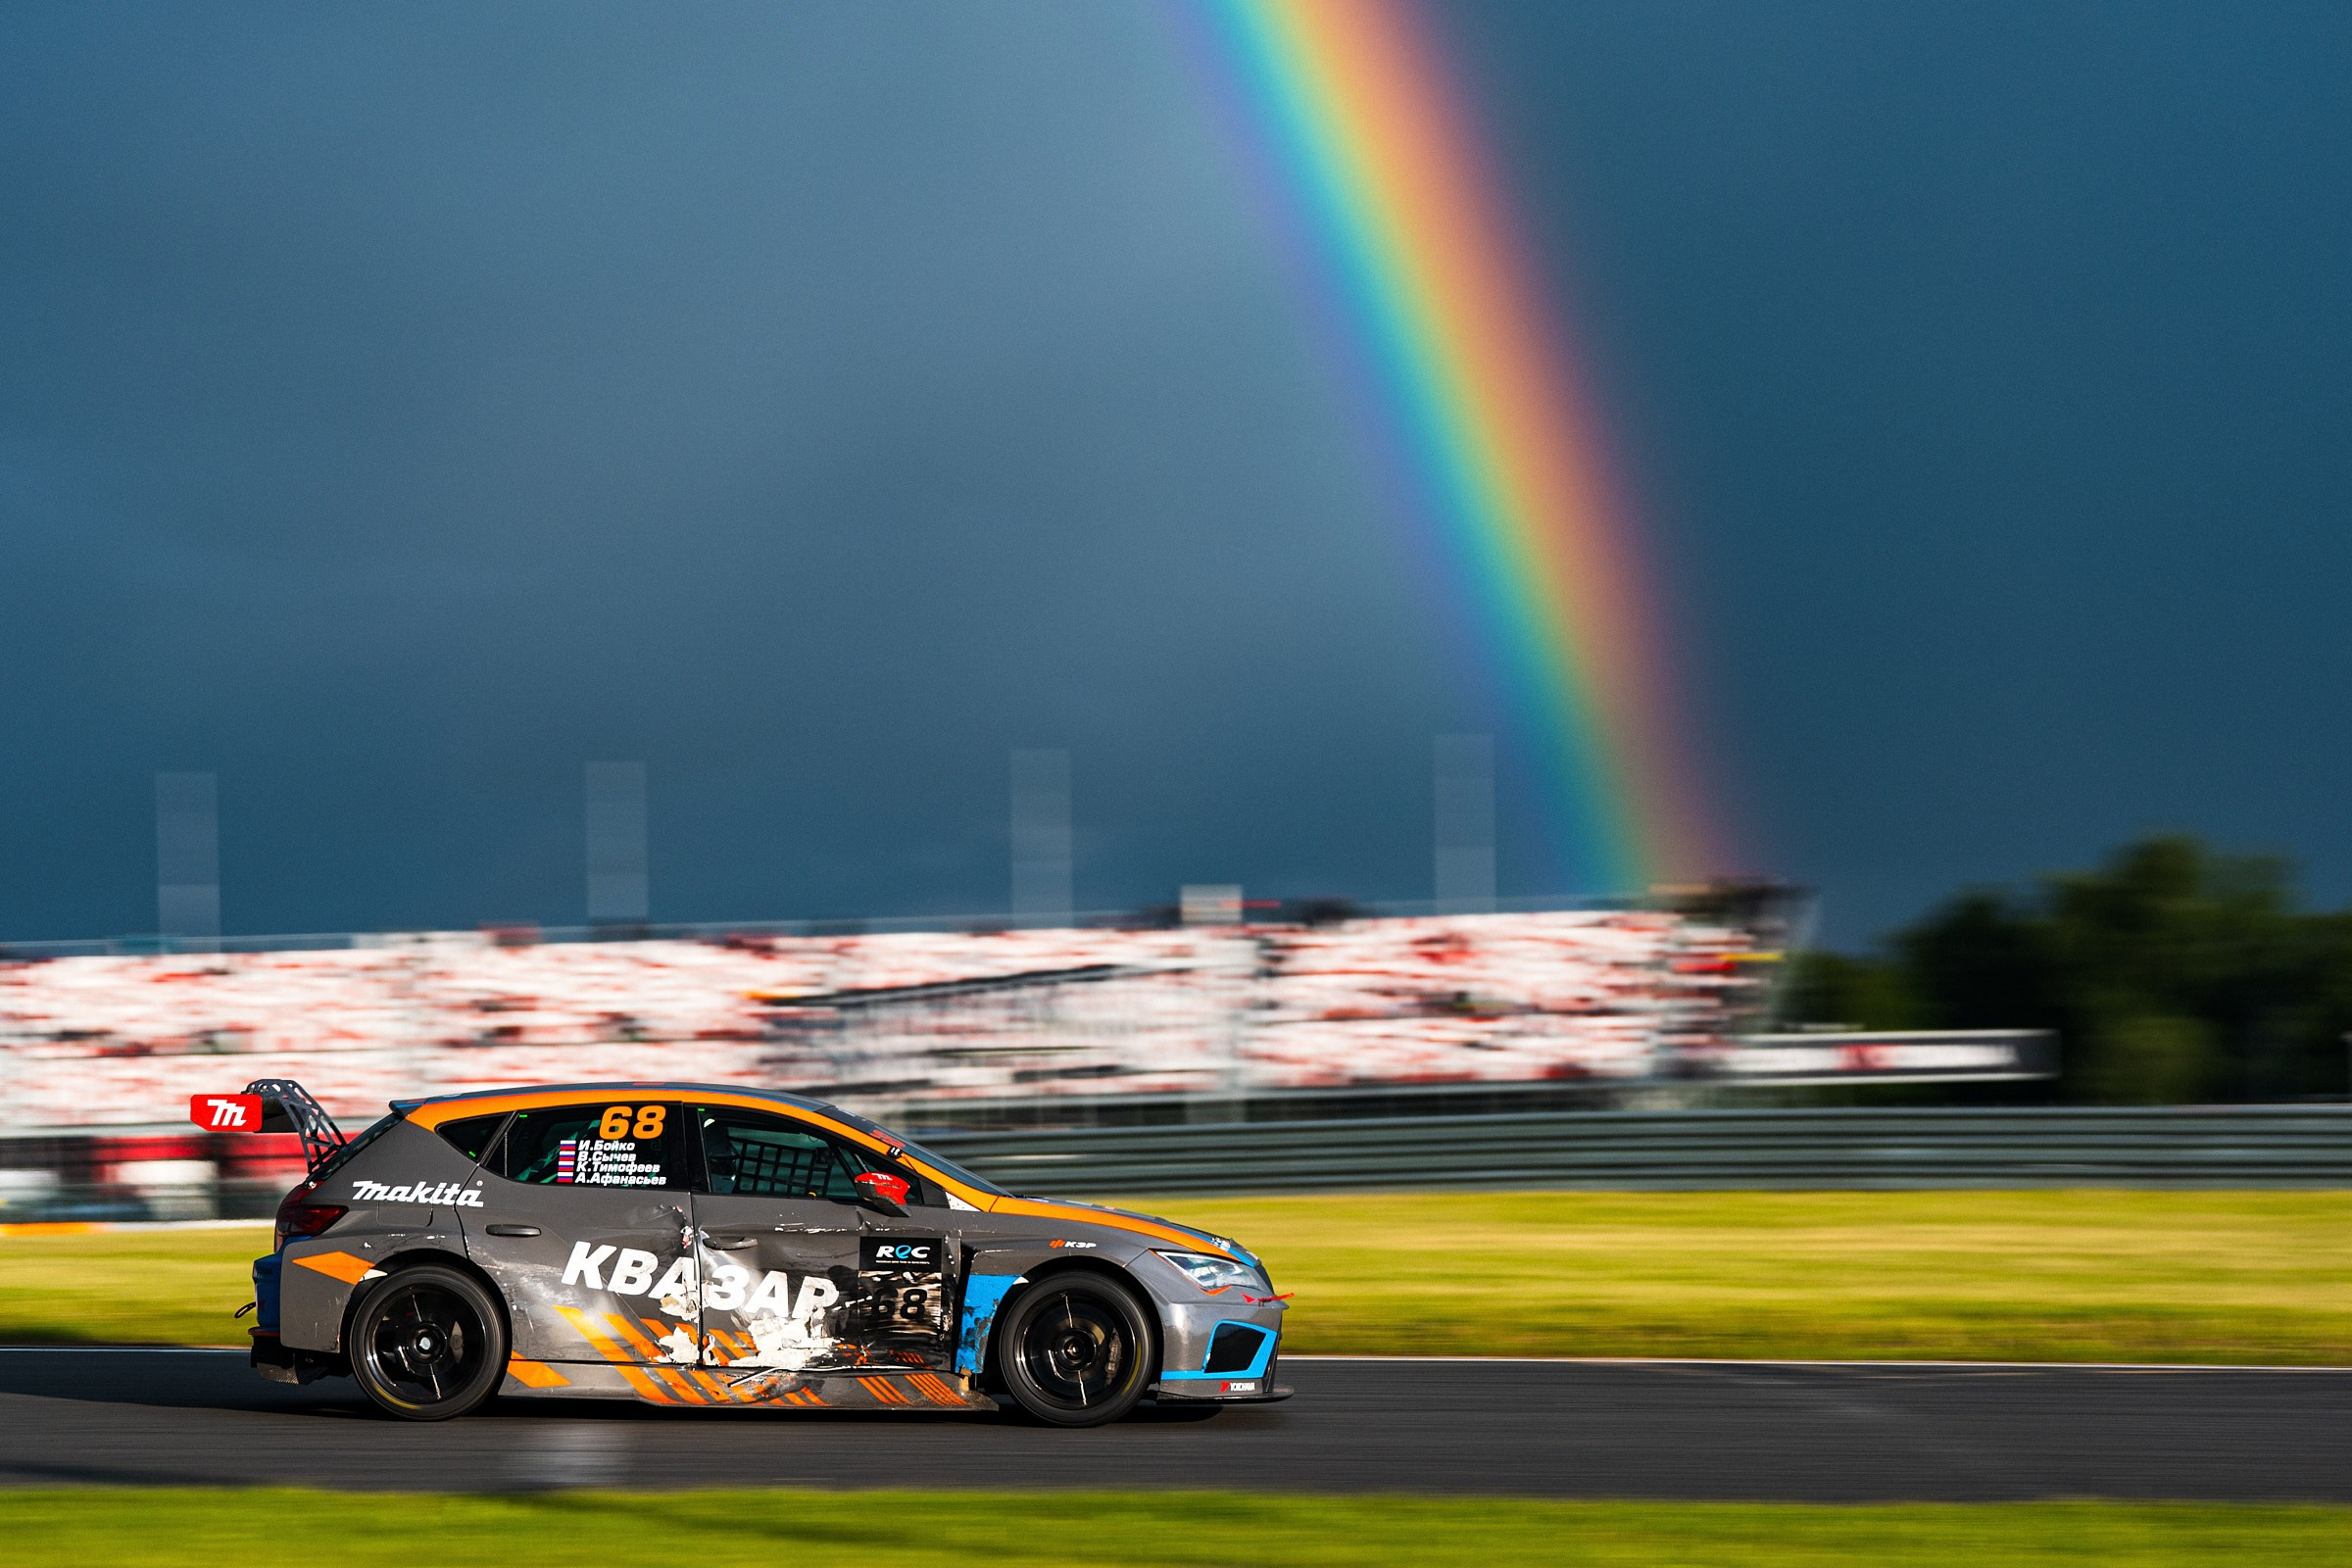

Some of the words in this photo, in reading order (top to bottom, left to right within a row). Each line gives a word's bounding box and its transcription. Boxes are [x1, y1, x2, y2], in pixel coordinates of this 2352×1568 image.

[600, 1105, 666, 1140] 68
[578, 1140, 635, 1151] И.Бойко
[577, 1151, 636, 1161] В.Сычев
[576, 1161, 661, 1175] К.Тимофеев
[575, 1172, 666, 1186] А.Афанасьев
[561, 1241, 840, 1319] КВАЗАР
